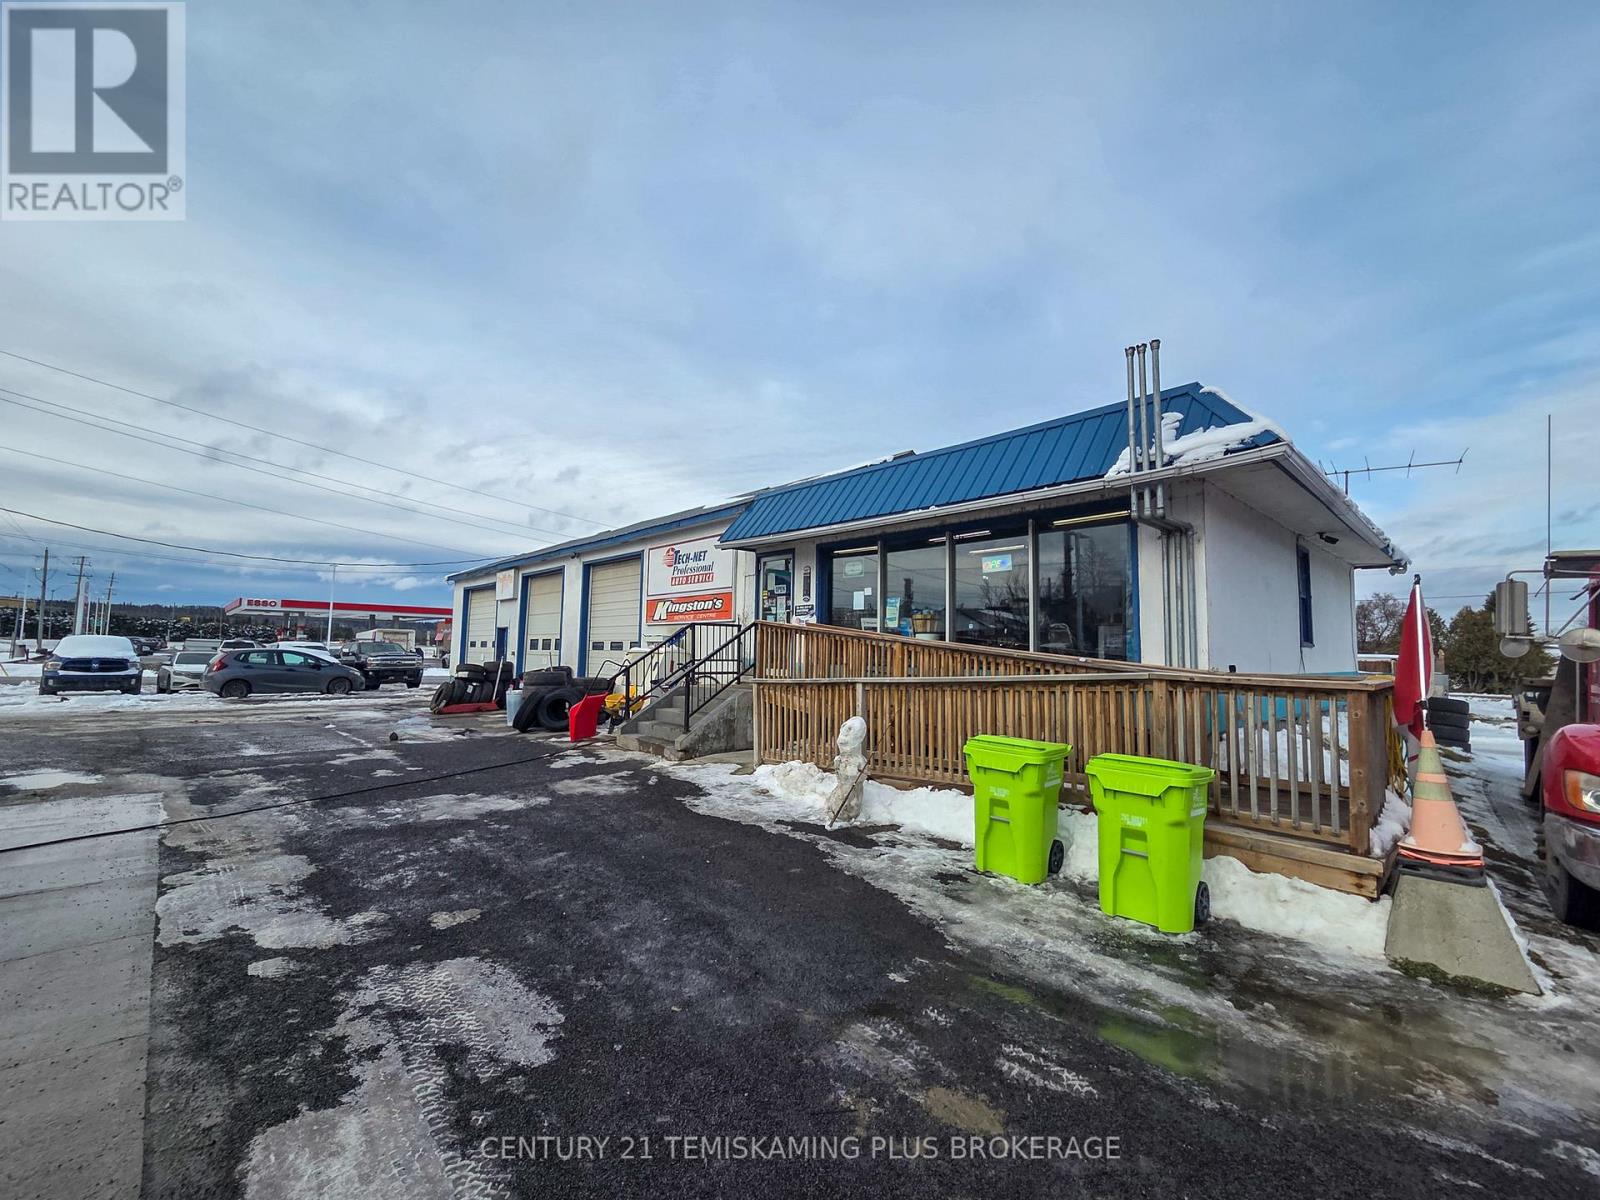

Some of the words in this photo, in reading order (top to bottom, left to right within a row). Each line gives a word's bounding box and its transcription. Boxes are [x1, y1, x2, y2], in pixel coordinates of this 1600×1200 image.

[674, 550, 708, 565] TECH-NET
[672, 561, 715, 576] Professional
[671, 576, 688, 586] AUTO
[688, 573, 714, 584] SERVICE
[652, 598, 724, 621] Kingston's
